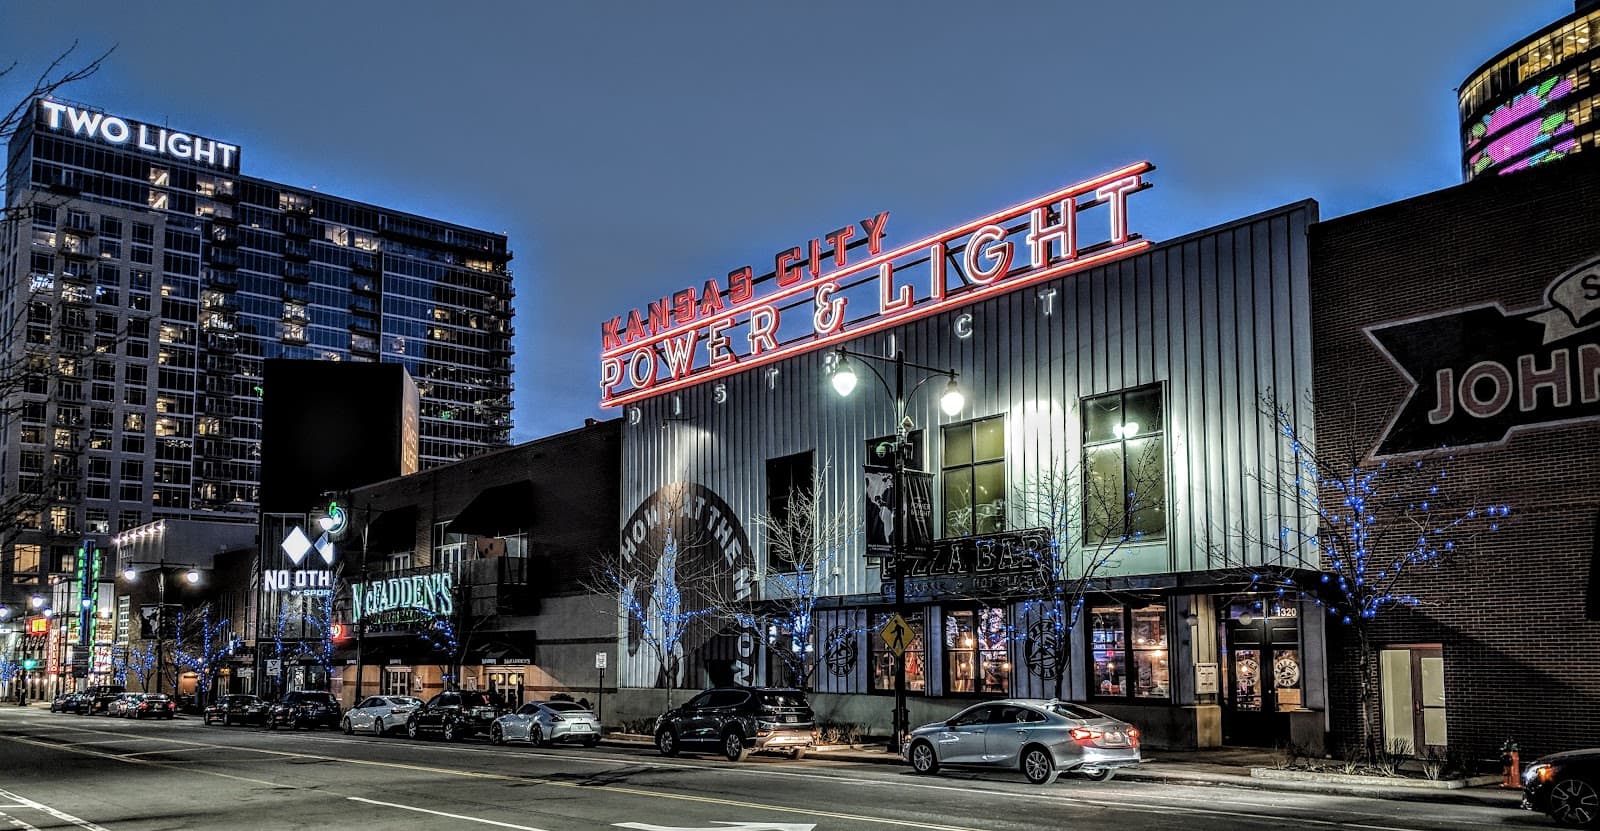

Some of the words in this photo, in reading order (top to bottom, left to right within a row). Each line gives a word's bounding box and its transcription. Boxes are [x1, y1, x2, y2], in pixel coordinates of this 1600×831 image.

[43, 101, 129, 143] TWO
[139, 124, 237, 168] LIGHT
[599, 304, 780, 401] POWER
[813, 281, 848, 336] &
[880, 174, 1142, 316] LIGHT
[601, 265, 753, 351] KANSAS
[775, 210, 890, 287] CITY
[630, 288, 1057, 426] DISTRICT
[707, 505, 742, 568] THE
[881, 543, 968, 579] PZZA
[976, 534, 1049, 572] BAR
[264, 569, 289, 591] NO
[303, 589, 332, 597] SPOR
[1277, 607, 1297, 617] 1320
